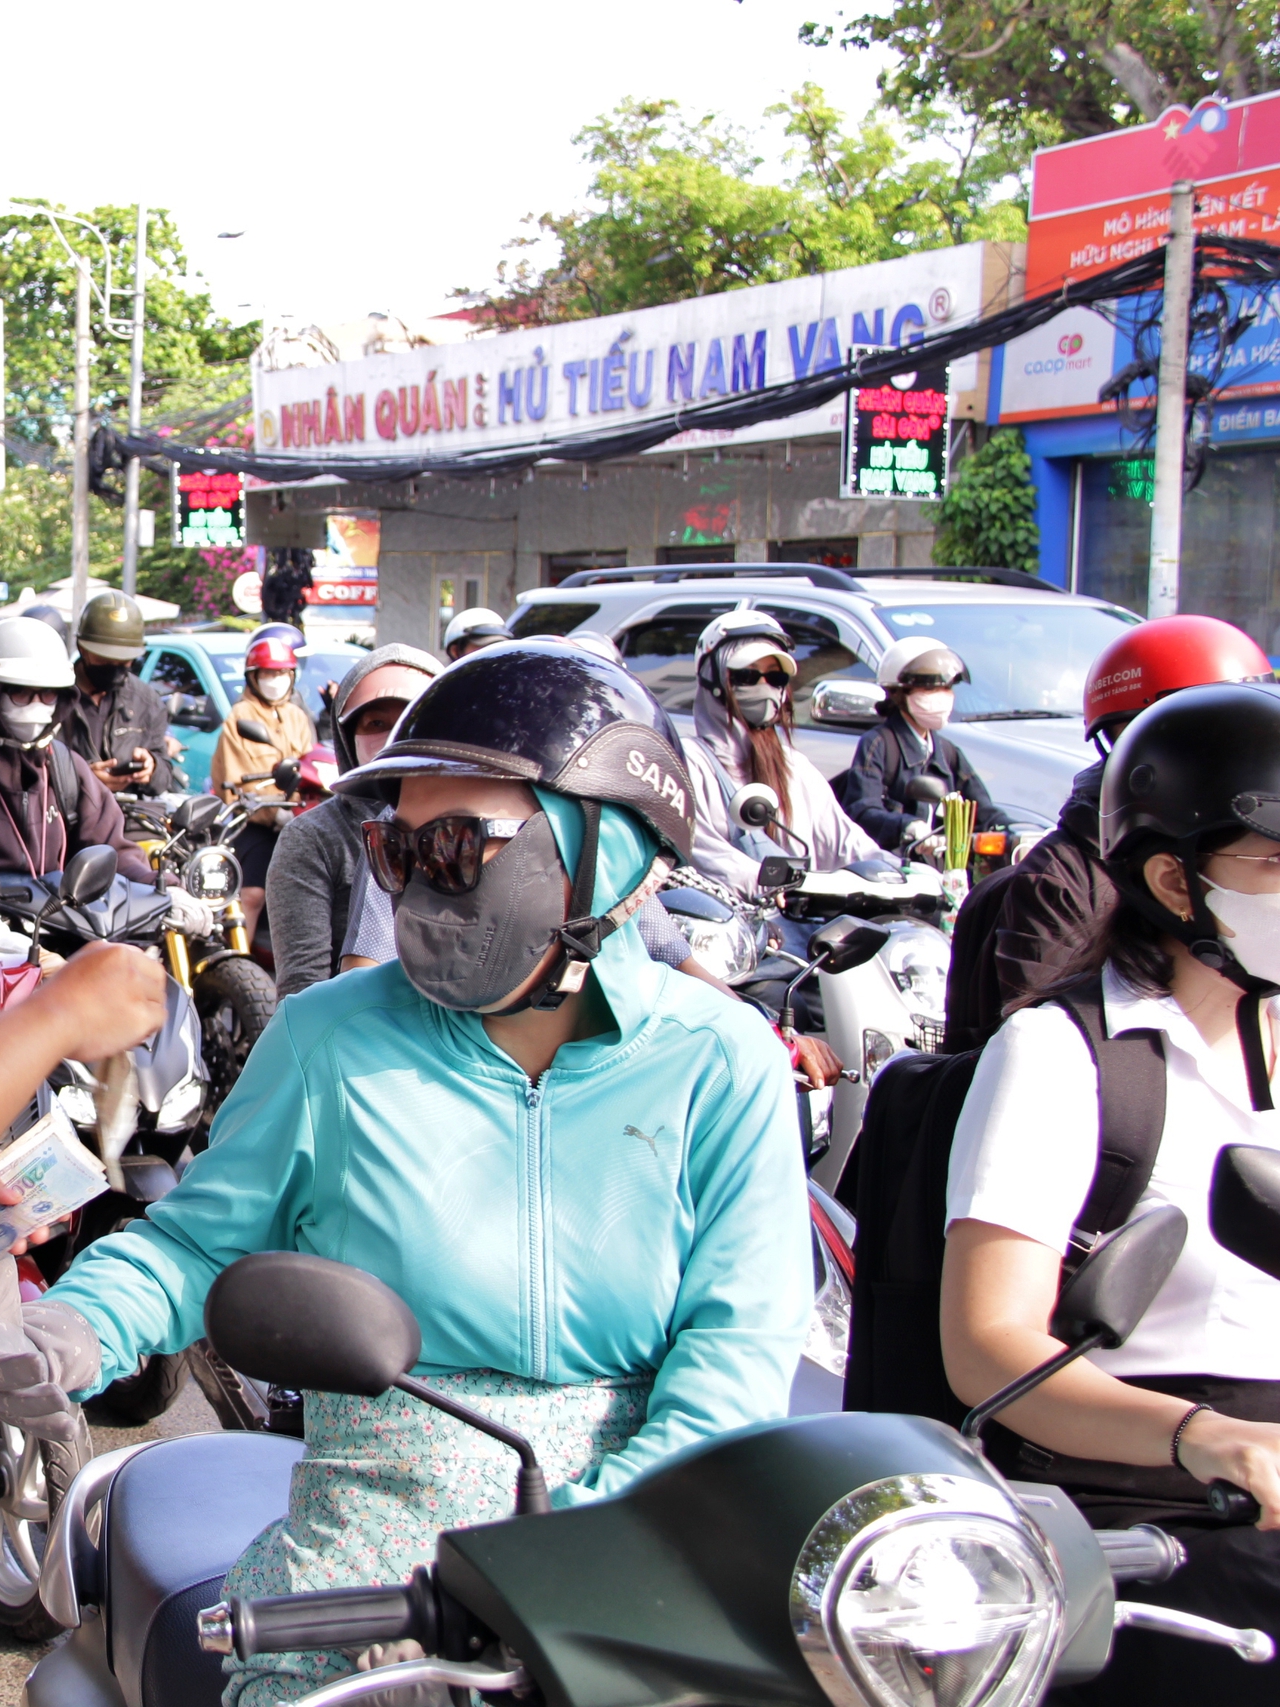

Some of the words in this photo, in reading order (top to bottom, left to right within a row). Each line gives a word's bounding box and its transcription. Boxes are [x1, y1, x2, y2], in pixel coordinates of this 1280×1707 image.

[1103, 211, 1132, 237] MÔ
[1135, 207, 1171, 229] HÌN
[1229, 181, 1269, 212] KẾT
[1071, 240, 1107, 267] HỮU
[281, 386, 365, 448] NHÂN
[375, 370, 468, 441] QUÁN
[498, 345, 548, 424] HỦ
[563, 329, 654, 416] TIẾU
[667, 330, 767, 402] NAM
[788, 303, 926, 381] VANG
[858, 385, 903, 413] NHÂN
[903, 388, 946, 414] QUÁN
[895, 469, 936, 492] VANG
[317, 584, 377, 601] COFF
[626, 750, 686, 819] SAPA
